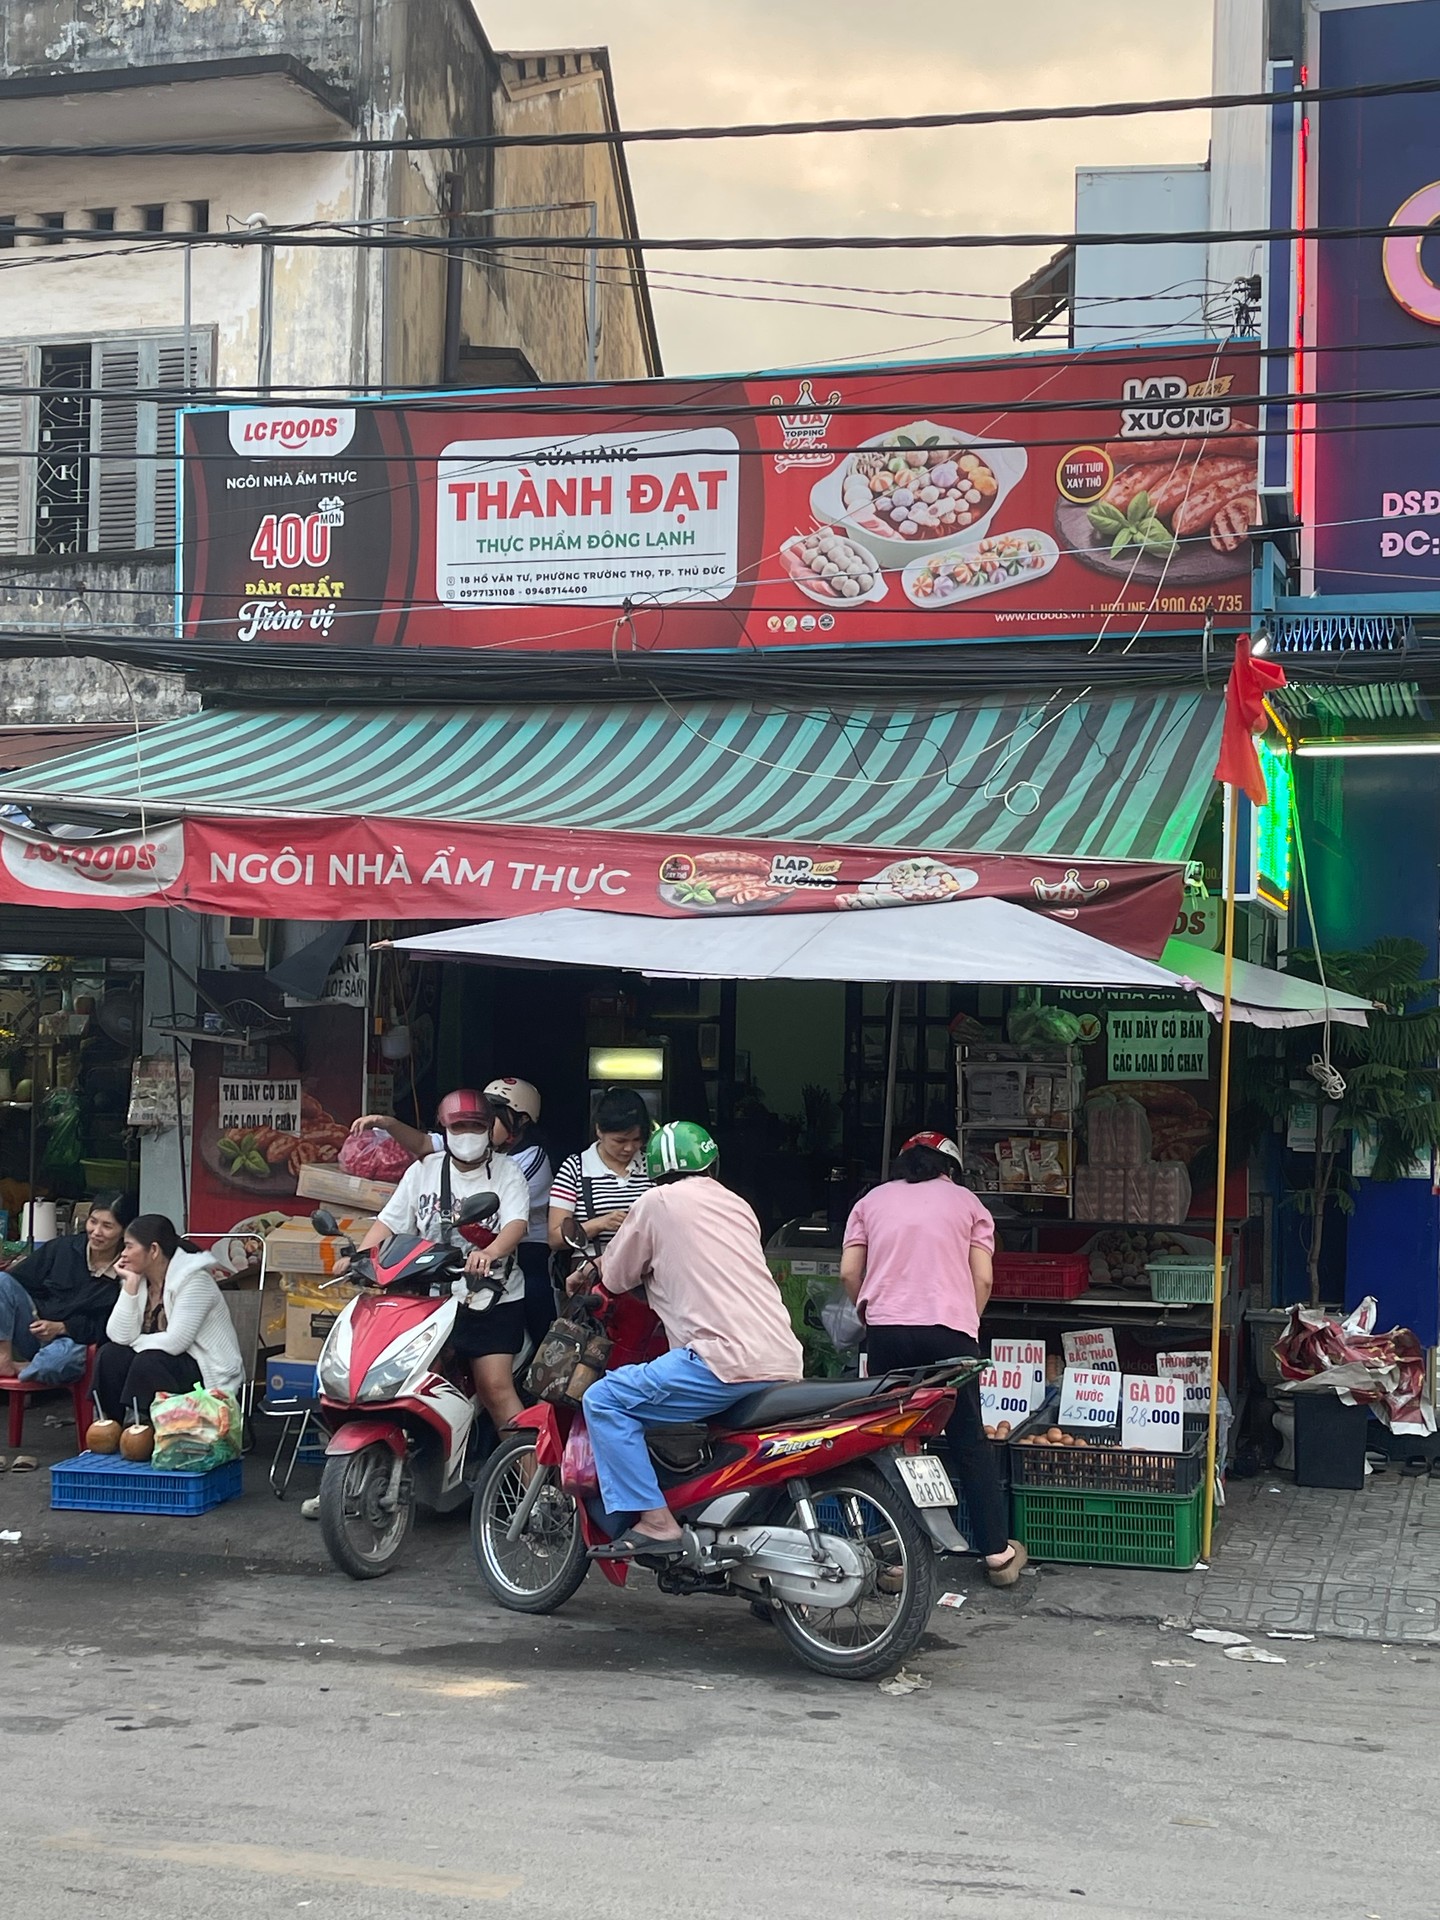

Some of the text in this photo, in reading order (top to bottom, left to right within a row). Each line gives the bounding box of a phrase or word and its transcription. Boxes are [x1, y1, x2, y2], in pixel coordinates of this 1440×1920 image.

[243, 417, 339, 442] LC FOODS
[785, 429, 825, 438] TOPPING
[581, 444, 639, 464] HÀNG
[226, 474, 261, 490] NGÔI
[263, 471, 294, 488] NHÀ
[319, 470, 358, 487] THỰC
[1065, 463, 1084, 476] THỊT
[1066, 475, 1102, 489] XAY THÔ
[447, 468, 729, 525] THÀNH ĐẠT
[251, 513, 330, 568] 400
[476, 529, 696, 556] THỰC PHẨM ĐÔNG LẠNH
[1380, 530, 1440, 558] ĐC:
[459, 576, 471, 584] 18
[491, 573, 513, 583] VĂN
[536, 571, 580, 582] PHƯỜNG
[583, 569, 627, 580] TRƯỜNG
[658, 569, 675, 577] TP.
[677, 565, 699, 576] THỦ
[702, 565, 726, 576] ĐỨC
[287, 576, 345, 599] CHẤT
[459, 588, 516, 598] 0977131108
[525, 585, 588, 596] 0948714400
[237, 600, 336, 642] Tròn vị
[57, 843, 158, 871] FOODS
[209, 844, 633, 901] NGÔI NHÀ ẨM THỰC
[1112, 1013, 1204, 1044] TẠI ĐÂY CÓ BÁN
[1112, 1049, 1132, 1073] CÁC
[1177, 1053, 1204, 1073] CHAY
[223, 1080, 298, 1106] TẠI ĐÂY CÓ BÁN
[222, 1110, 240, 1130] CÁC
[1002, 1364, 1022, 1389] ĐỎ
[1073, 1372, 1089, 1387] VỊT
[1129, 1378, 1176, 1405] GÀ ĐỎ
[1062, 1404, 1116, 1423] 45.000
[1126, 1405, 1181, 1427] 28.000
